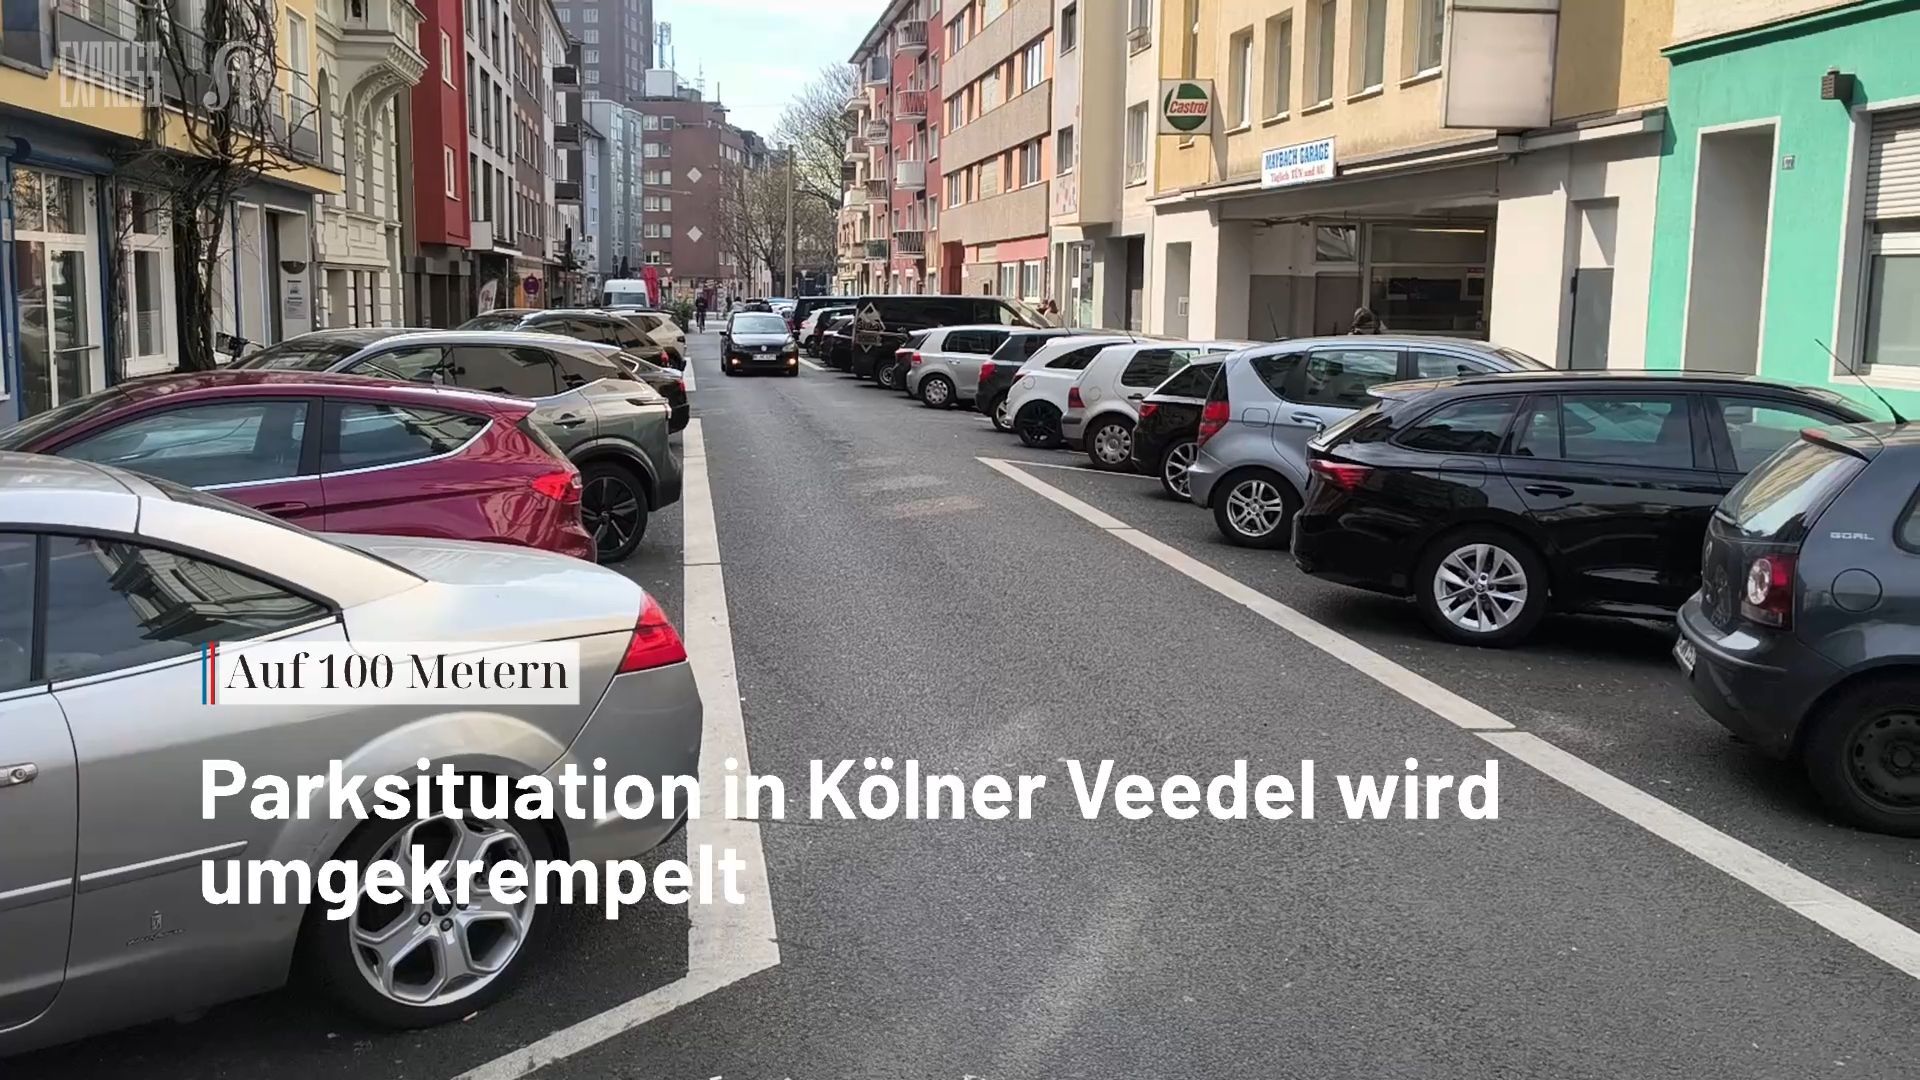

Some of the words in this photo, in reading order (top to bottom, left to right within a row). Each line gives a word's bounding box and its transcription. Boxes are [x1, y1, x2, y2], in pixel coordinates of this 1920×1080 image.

[1170, 100, 1208, 113] Castrol
[1265, 148, 1298, 170] MAYBACH
[1300, 142, 1329, 164] GARAGE
[1304, 165, 1315, 177] und
[1830, 531, 1875, 541] GOAL
